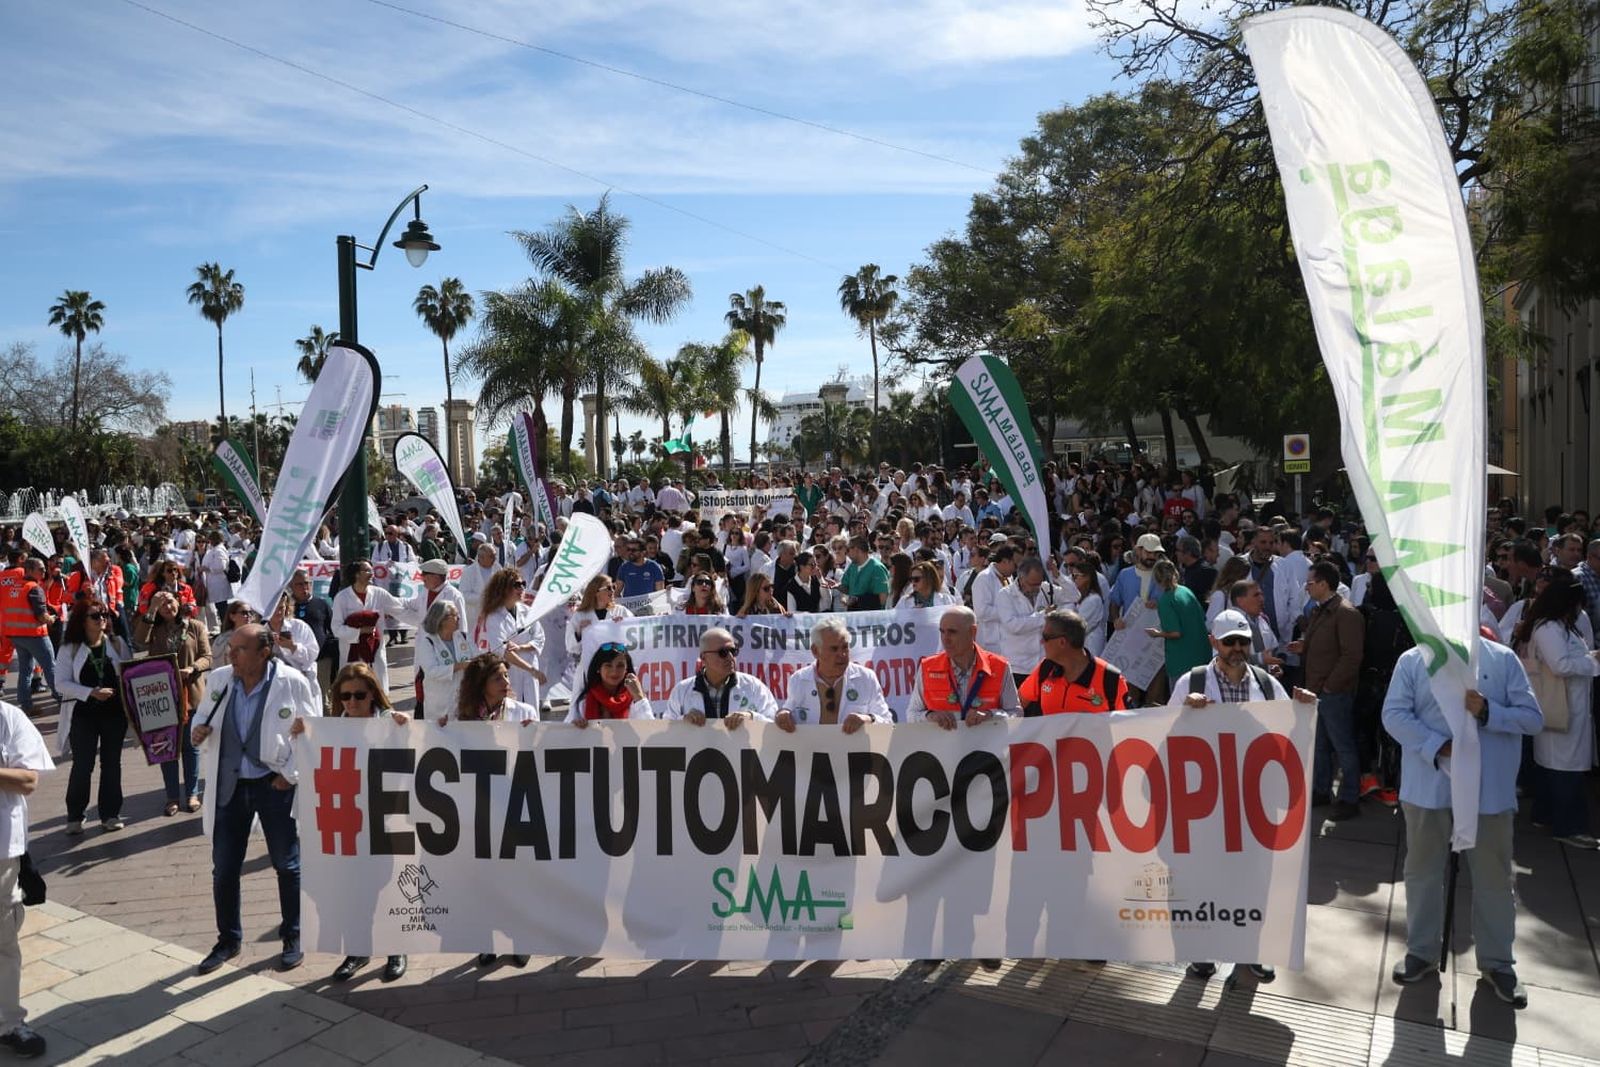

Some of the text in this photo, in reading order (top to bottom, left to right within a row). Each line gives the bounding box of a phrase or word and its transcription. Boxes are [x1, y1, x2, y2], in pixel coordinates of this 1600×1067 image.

[970, 372, 1036, 485] SMA Málaga
[626, 625, 645, 651] SI
[751, 624, 787, 651] SIN
[138, 696, 170, 718] MARCO
[314, 732, 1306, 861] #ESTATUTOMARCOPROPIO
[712, 863, 817, 924] SMA
[388, 905, 449, 916] ASOCIACIÓN
[409, 915, 427, 923] MIR
[1118, 902, 1263, 927] commálaga
[401, 921, 438, 932] ESPAÑA
